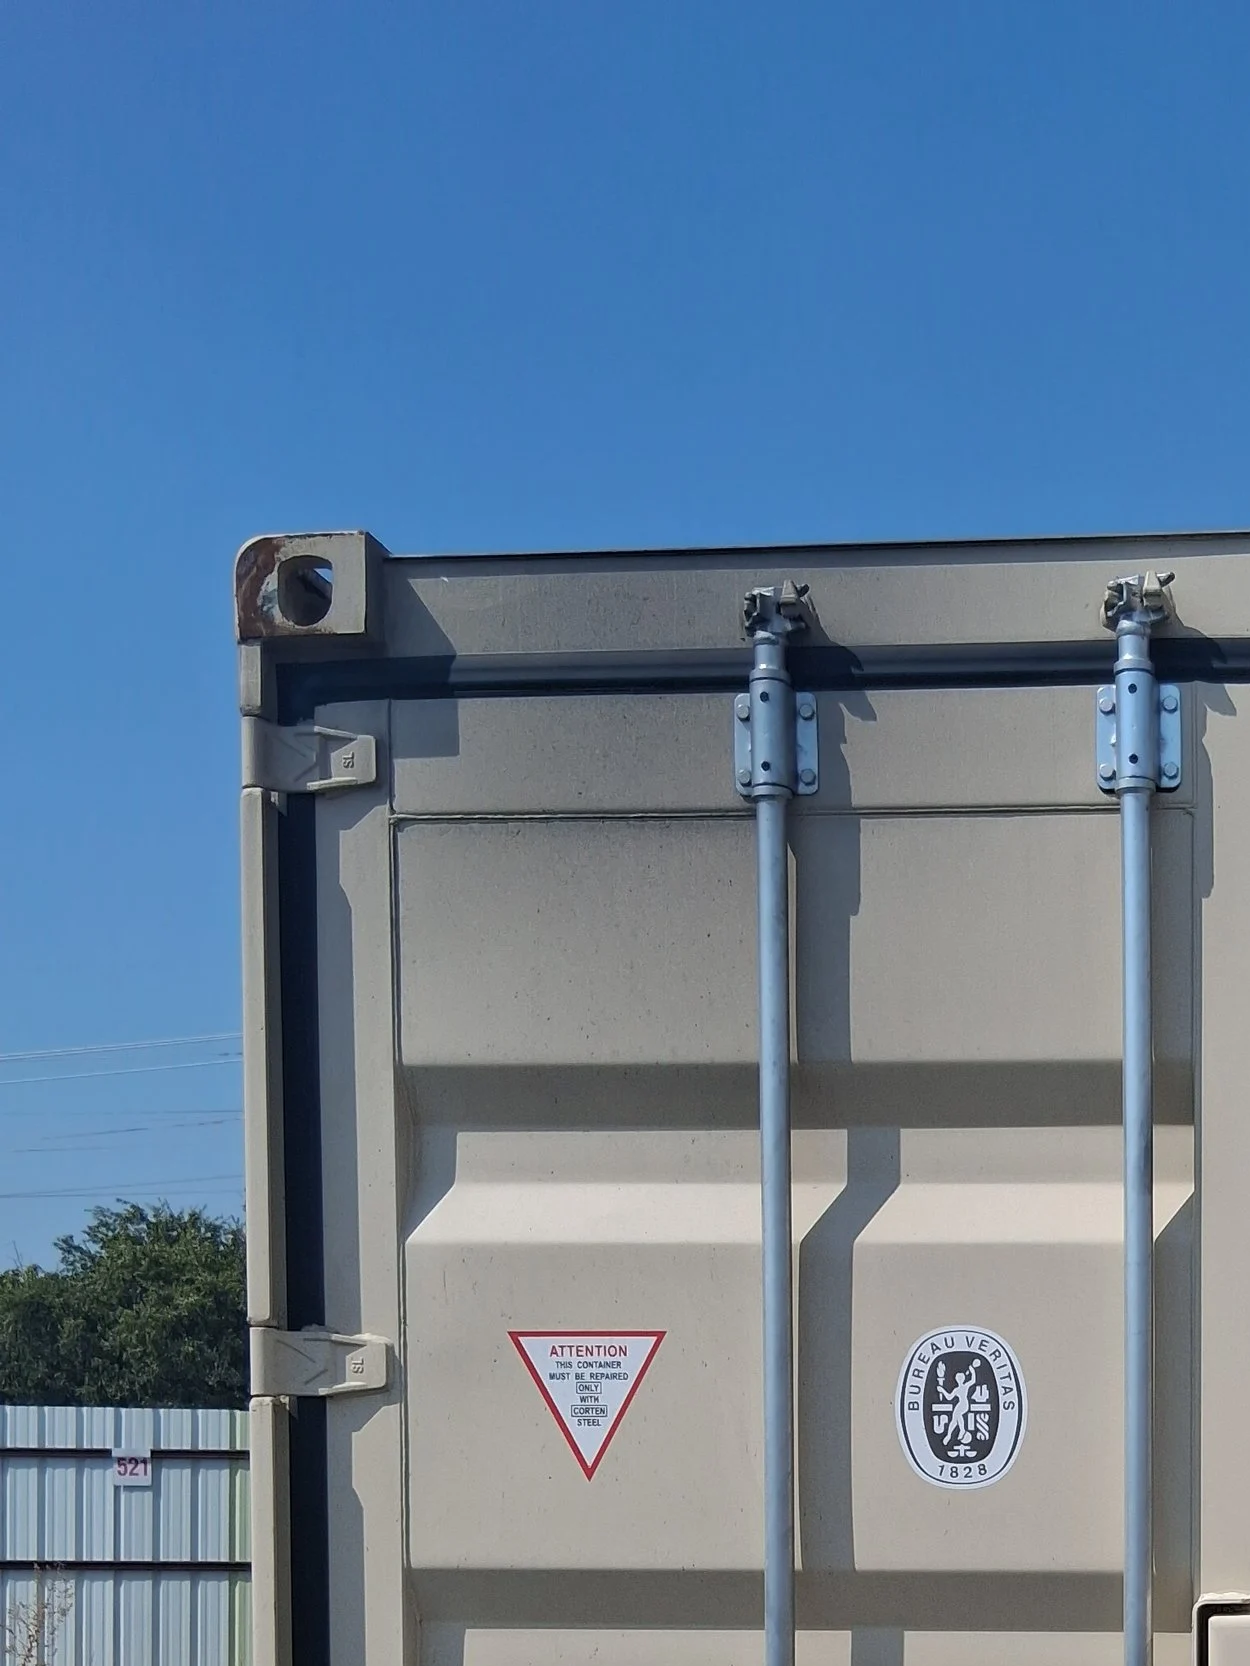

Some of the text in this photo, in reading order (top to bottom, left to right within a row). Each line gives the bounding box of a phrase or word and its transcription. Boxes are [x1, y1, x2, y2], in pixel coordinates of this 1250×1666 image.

[549, 1344, 628, 1358] ATTENTION
[555, 1360, 622, 1369] THIS CONTAINER
[548, 1372, 629, 1381] MUST BE REPAIRED
[907, 1335, 1016, 1411] BUREAU VERITAS
[578, 1384, 600, 1392] ONLY
[579, 1395, 600, 1404] WITH
[573, 1407, 606, 1415] CORTEN
[577, 1418, 602, 1427] STEEL
[116, 1456, 149, 1477] 521
[937, 1463, 988, 1479] 1828
